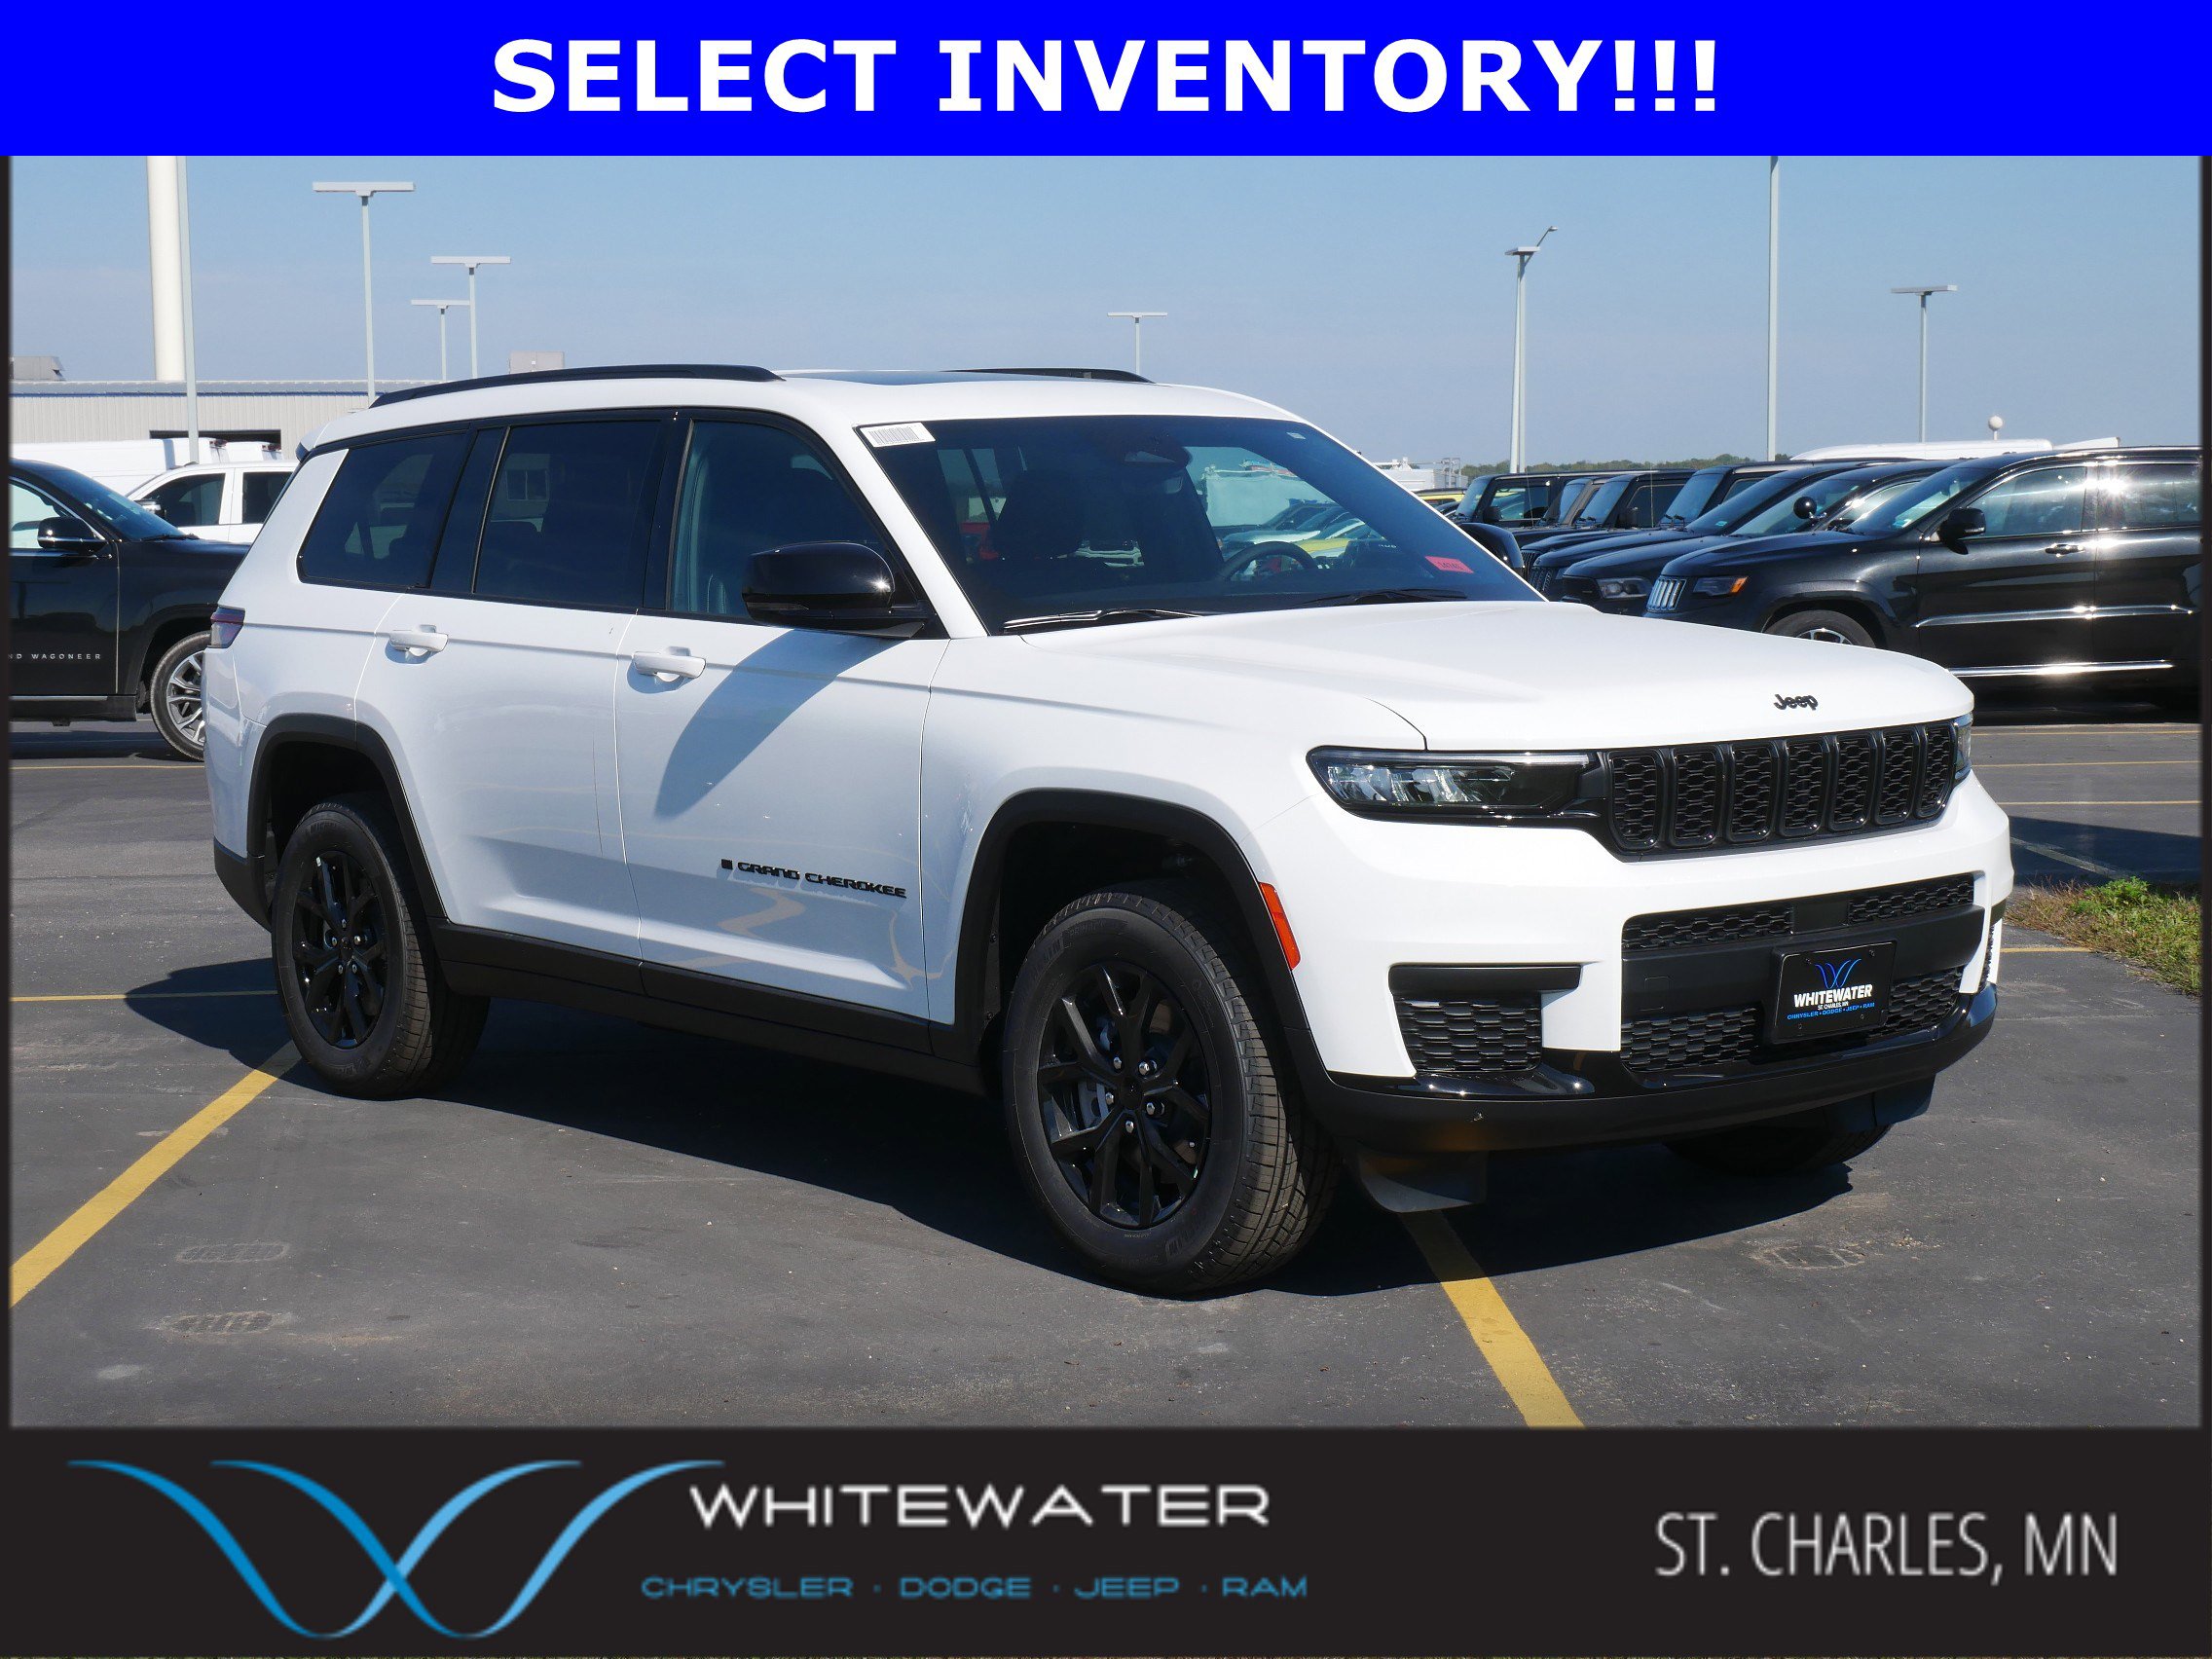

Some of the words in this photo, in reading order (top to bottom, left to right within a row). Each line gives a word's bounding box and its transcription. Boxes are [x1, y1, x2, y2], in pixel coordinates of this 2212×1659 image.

[1773, 693, 1819, 711] Jeep
[737, 862, 801, 880] GRAND
[804, 872, 907, 899] CHEROKEE
[1793, 983, 1873, 1008] WHITEWATER
[1787, 1011, 1819, 1020] CHRYSLER
